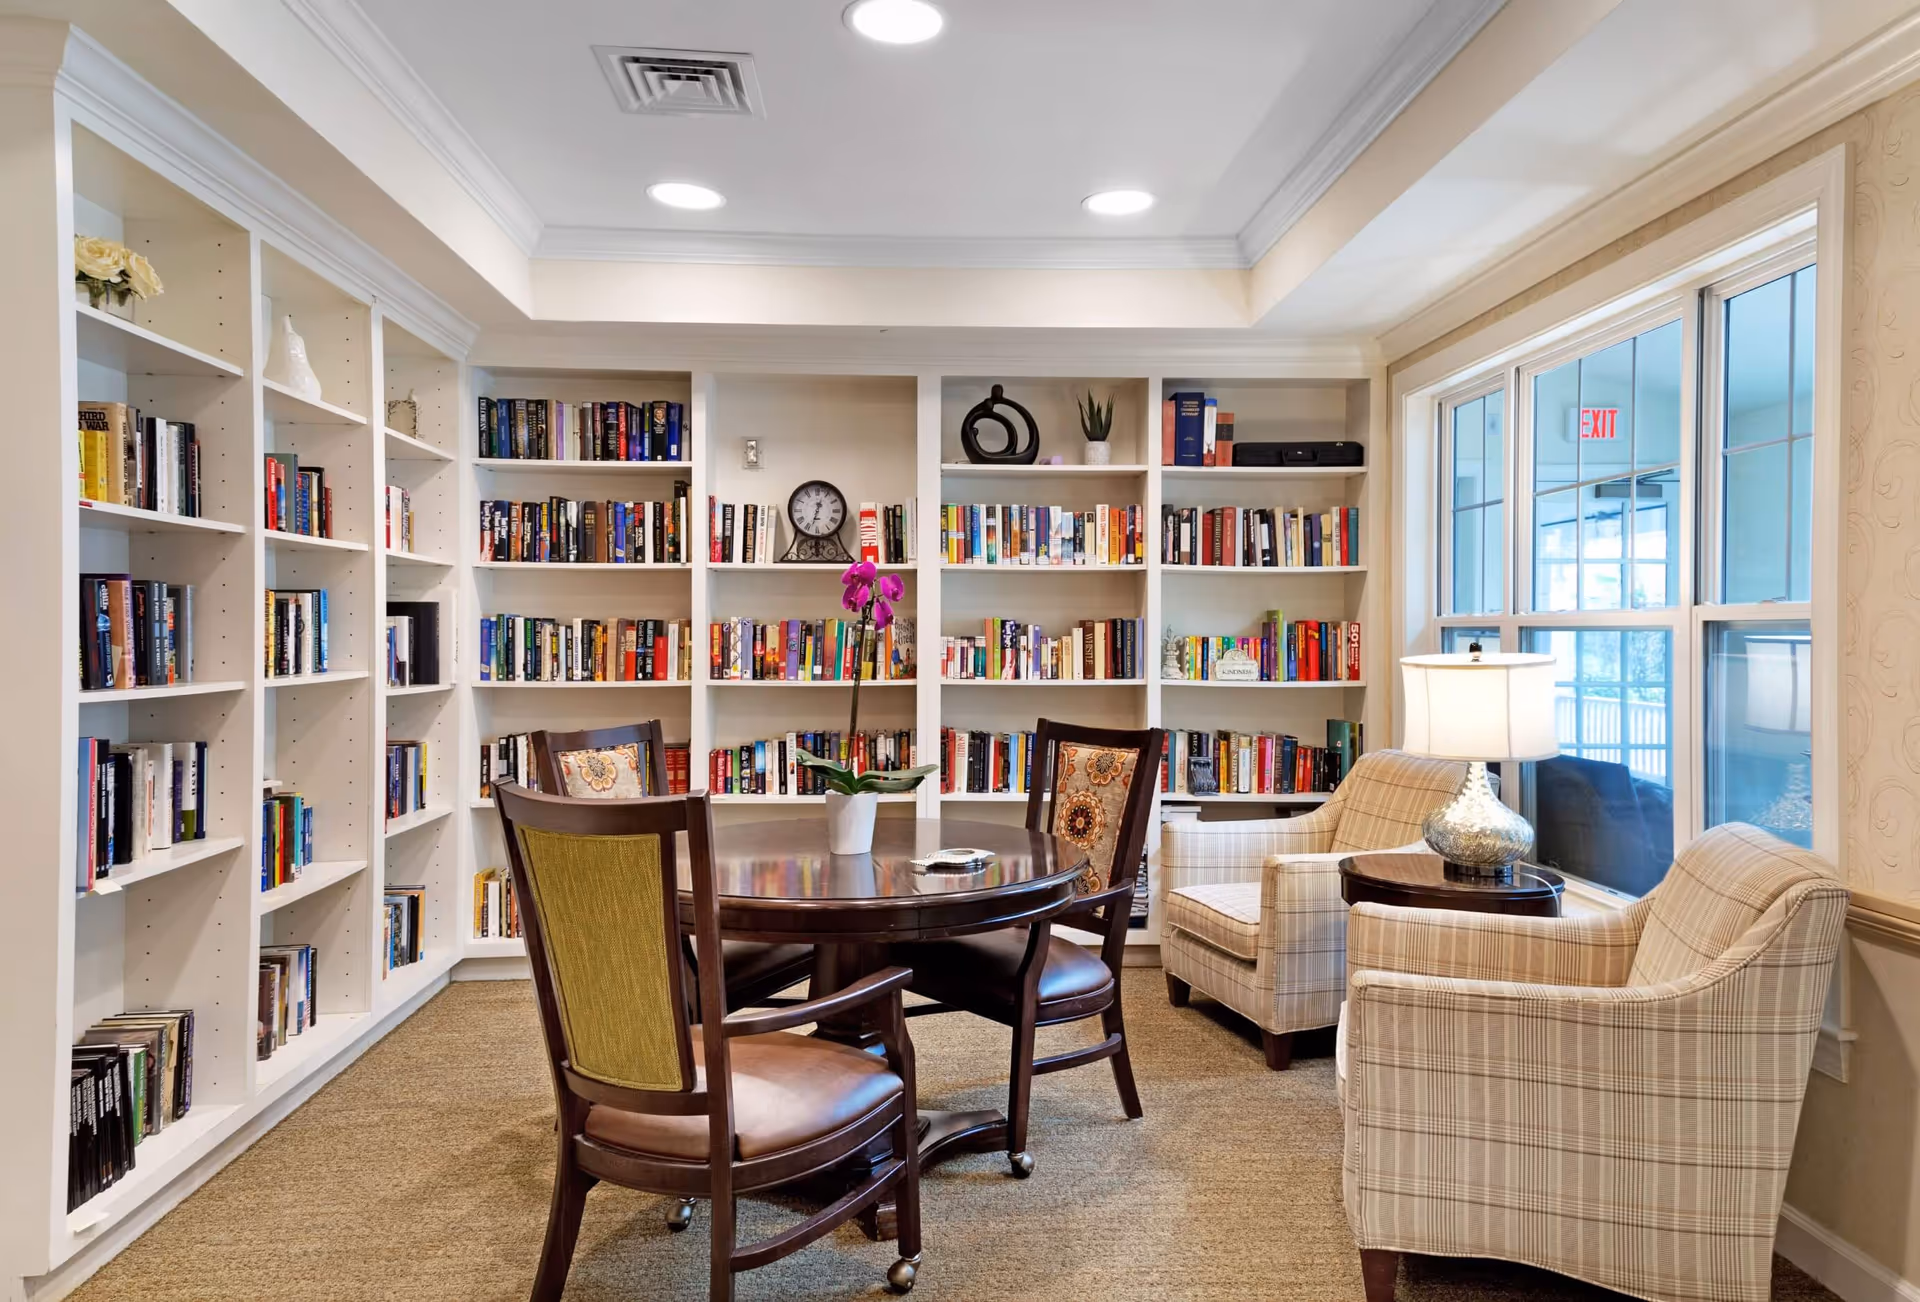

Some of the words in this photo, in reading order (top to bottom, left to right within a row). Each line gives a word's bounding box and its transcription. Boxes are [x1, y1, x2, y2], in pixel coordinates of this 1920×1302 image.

[78, 411, 106, 421] HIRD
[86, 421, 110, 431] WAR
[1582, 409, 1618, 438] EXIT
[510, 518, 519, 536] Clancy
[860, 521, 877, 547] KING
[1351, 624, 1359, 647] 501
[1085, 633, 1093, 665] WHISTLE
